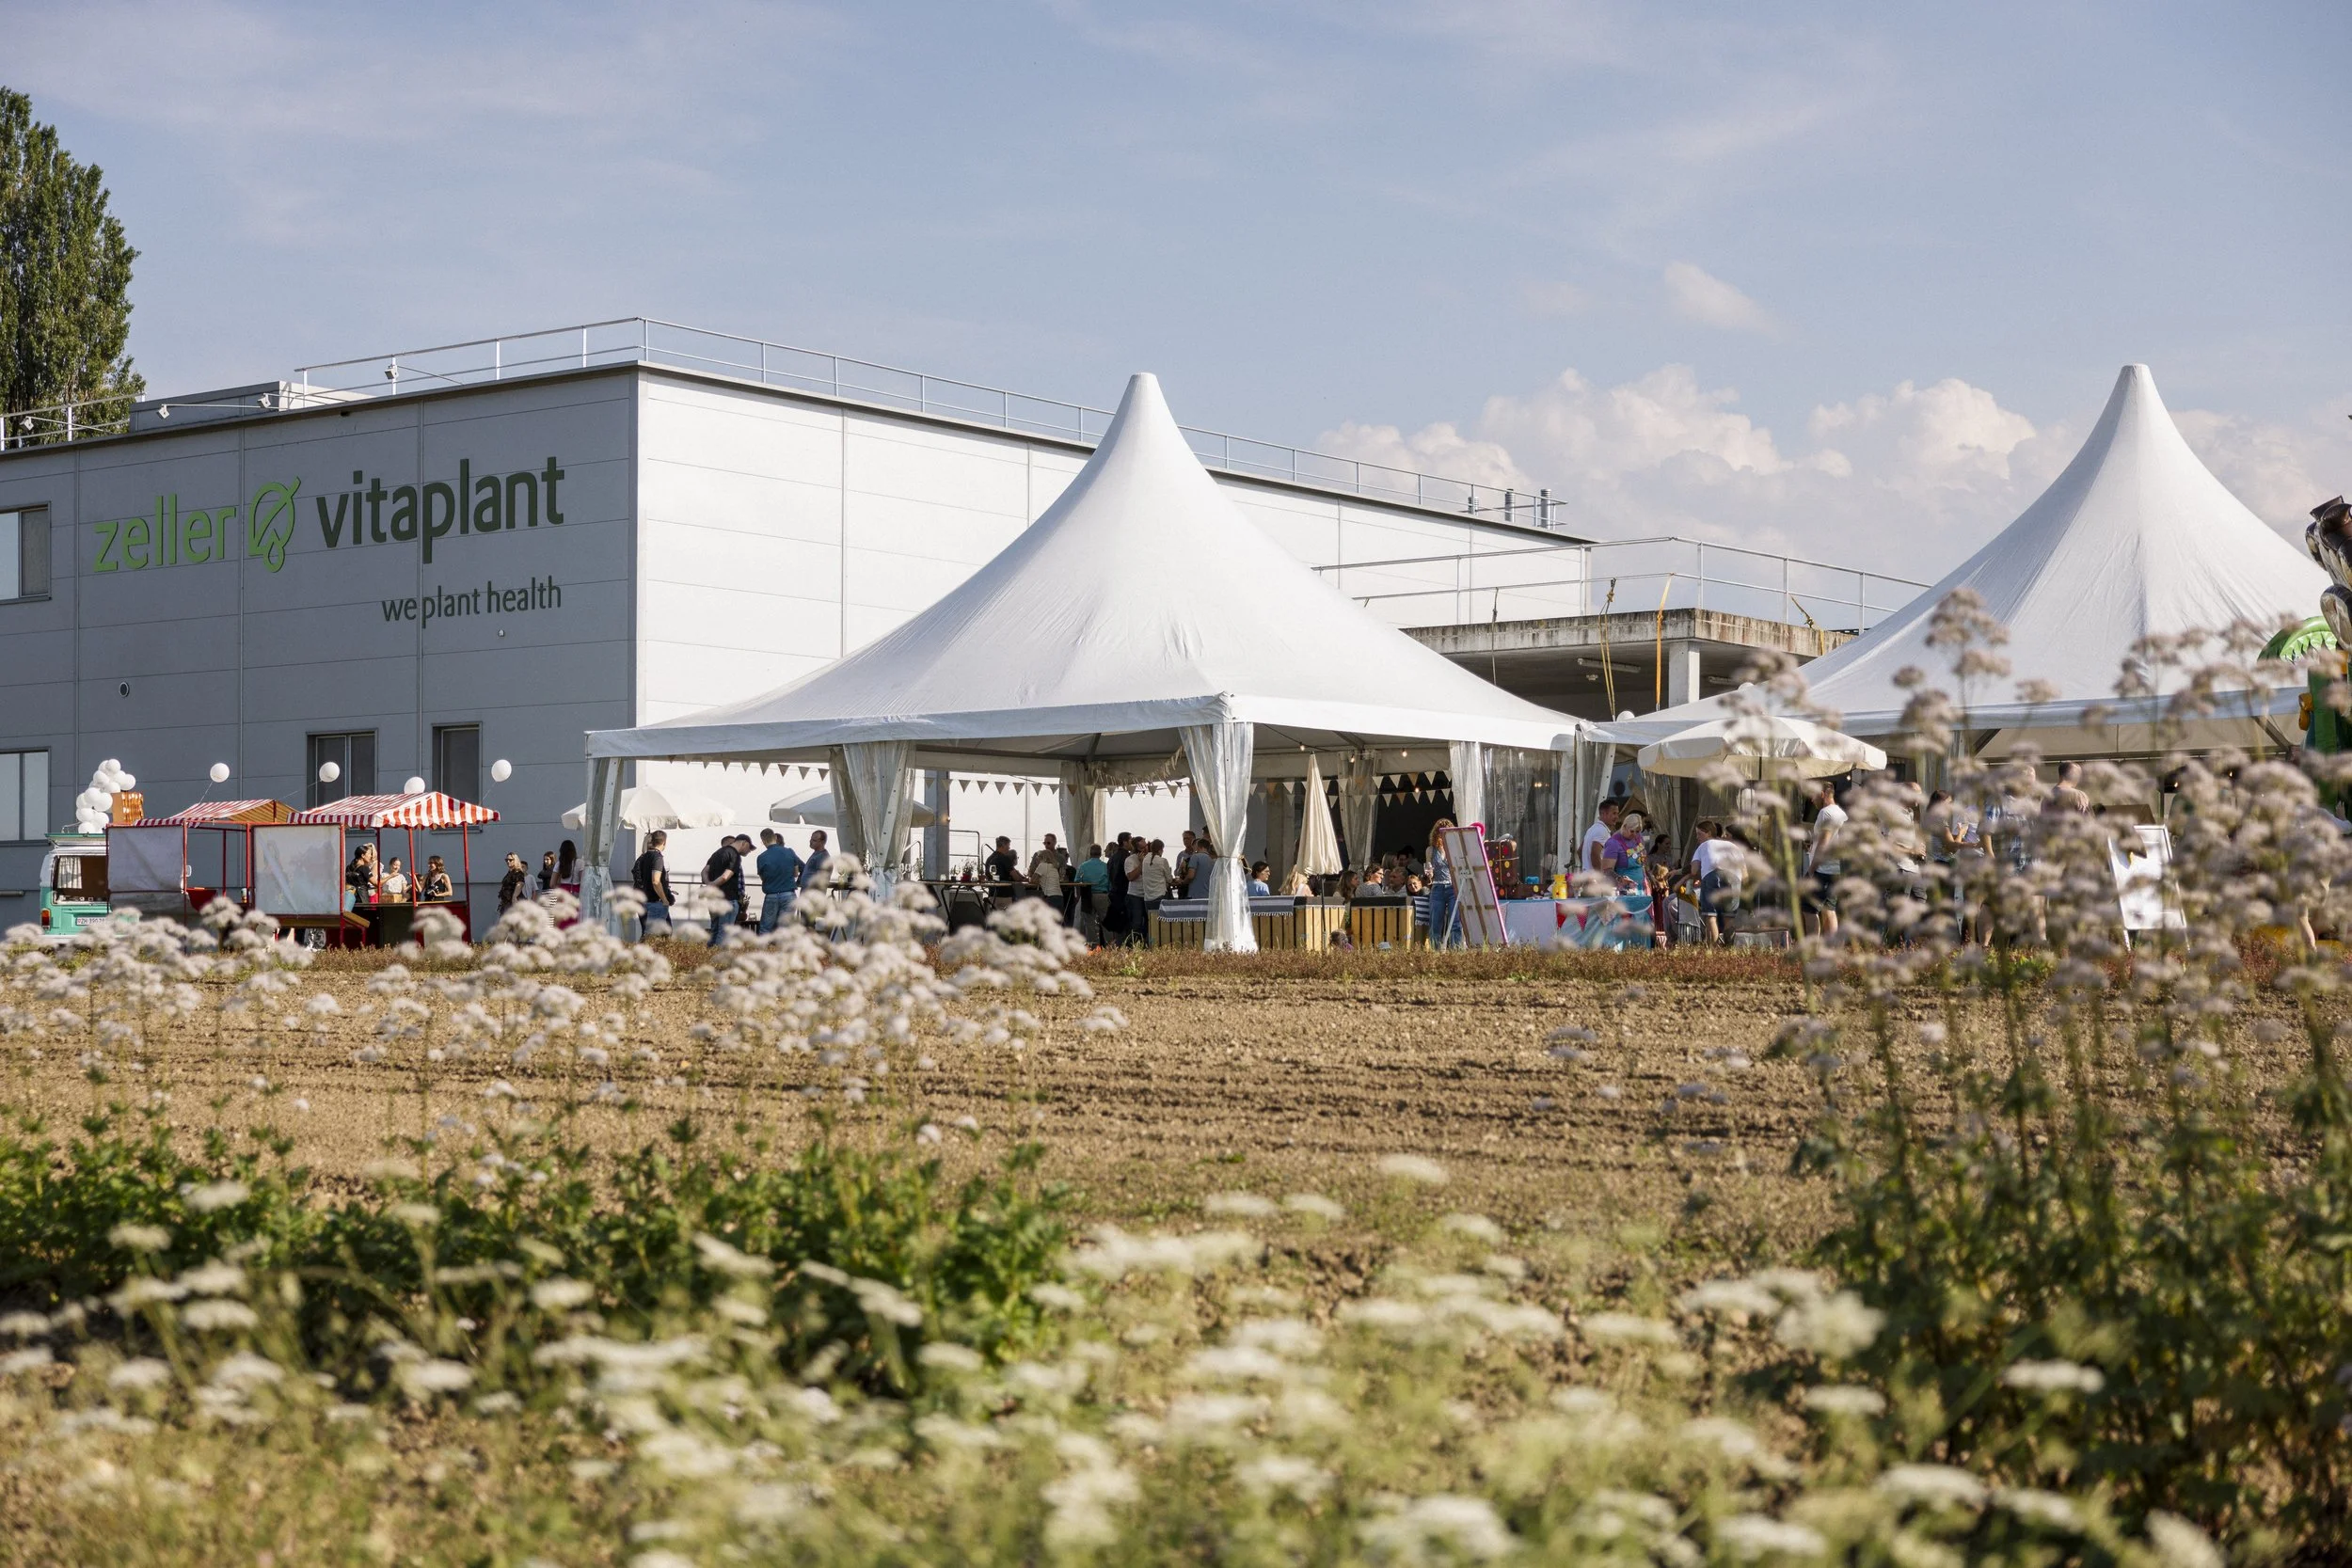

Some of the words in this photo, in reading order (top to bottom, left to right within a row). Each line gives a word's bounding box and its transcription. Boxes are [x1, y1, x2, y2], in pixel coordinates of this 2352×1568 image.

[93, 493, 236, 573] zeller
[315, 456, 565, 564] vitaplant
[381, 597, 417, 622] we
[421, 585, 481, 629] plant
[486, 575, 562, 613] health
